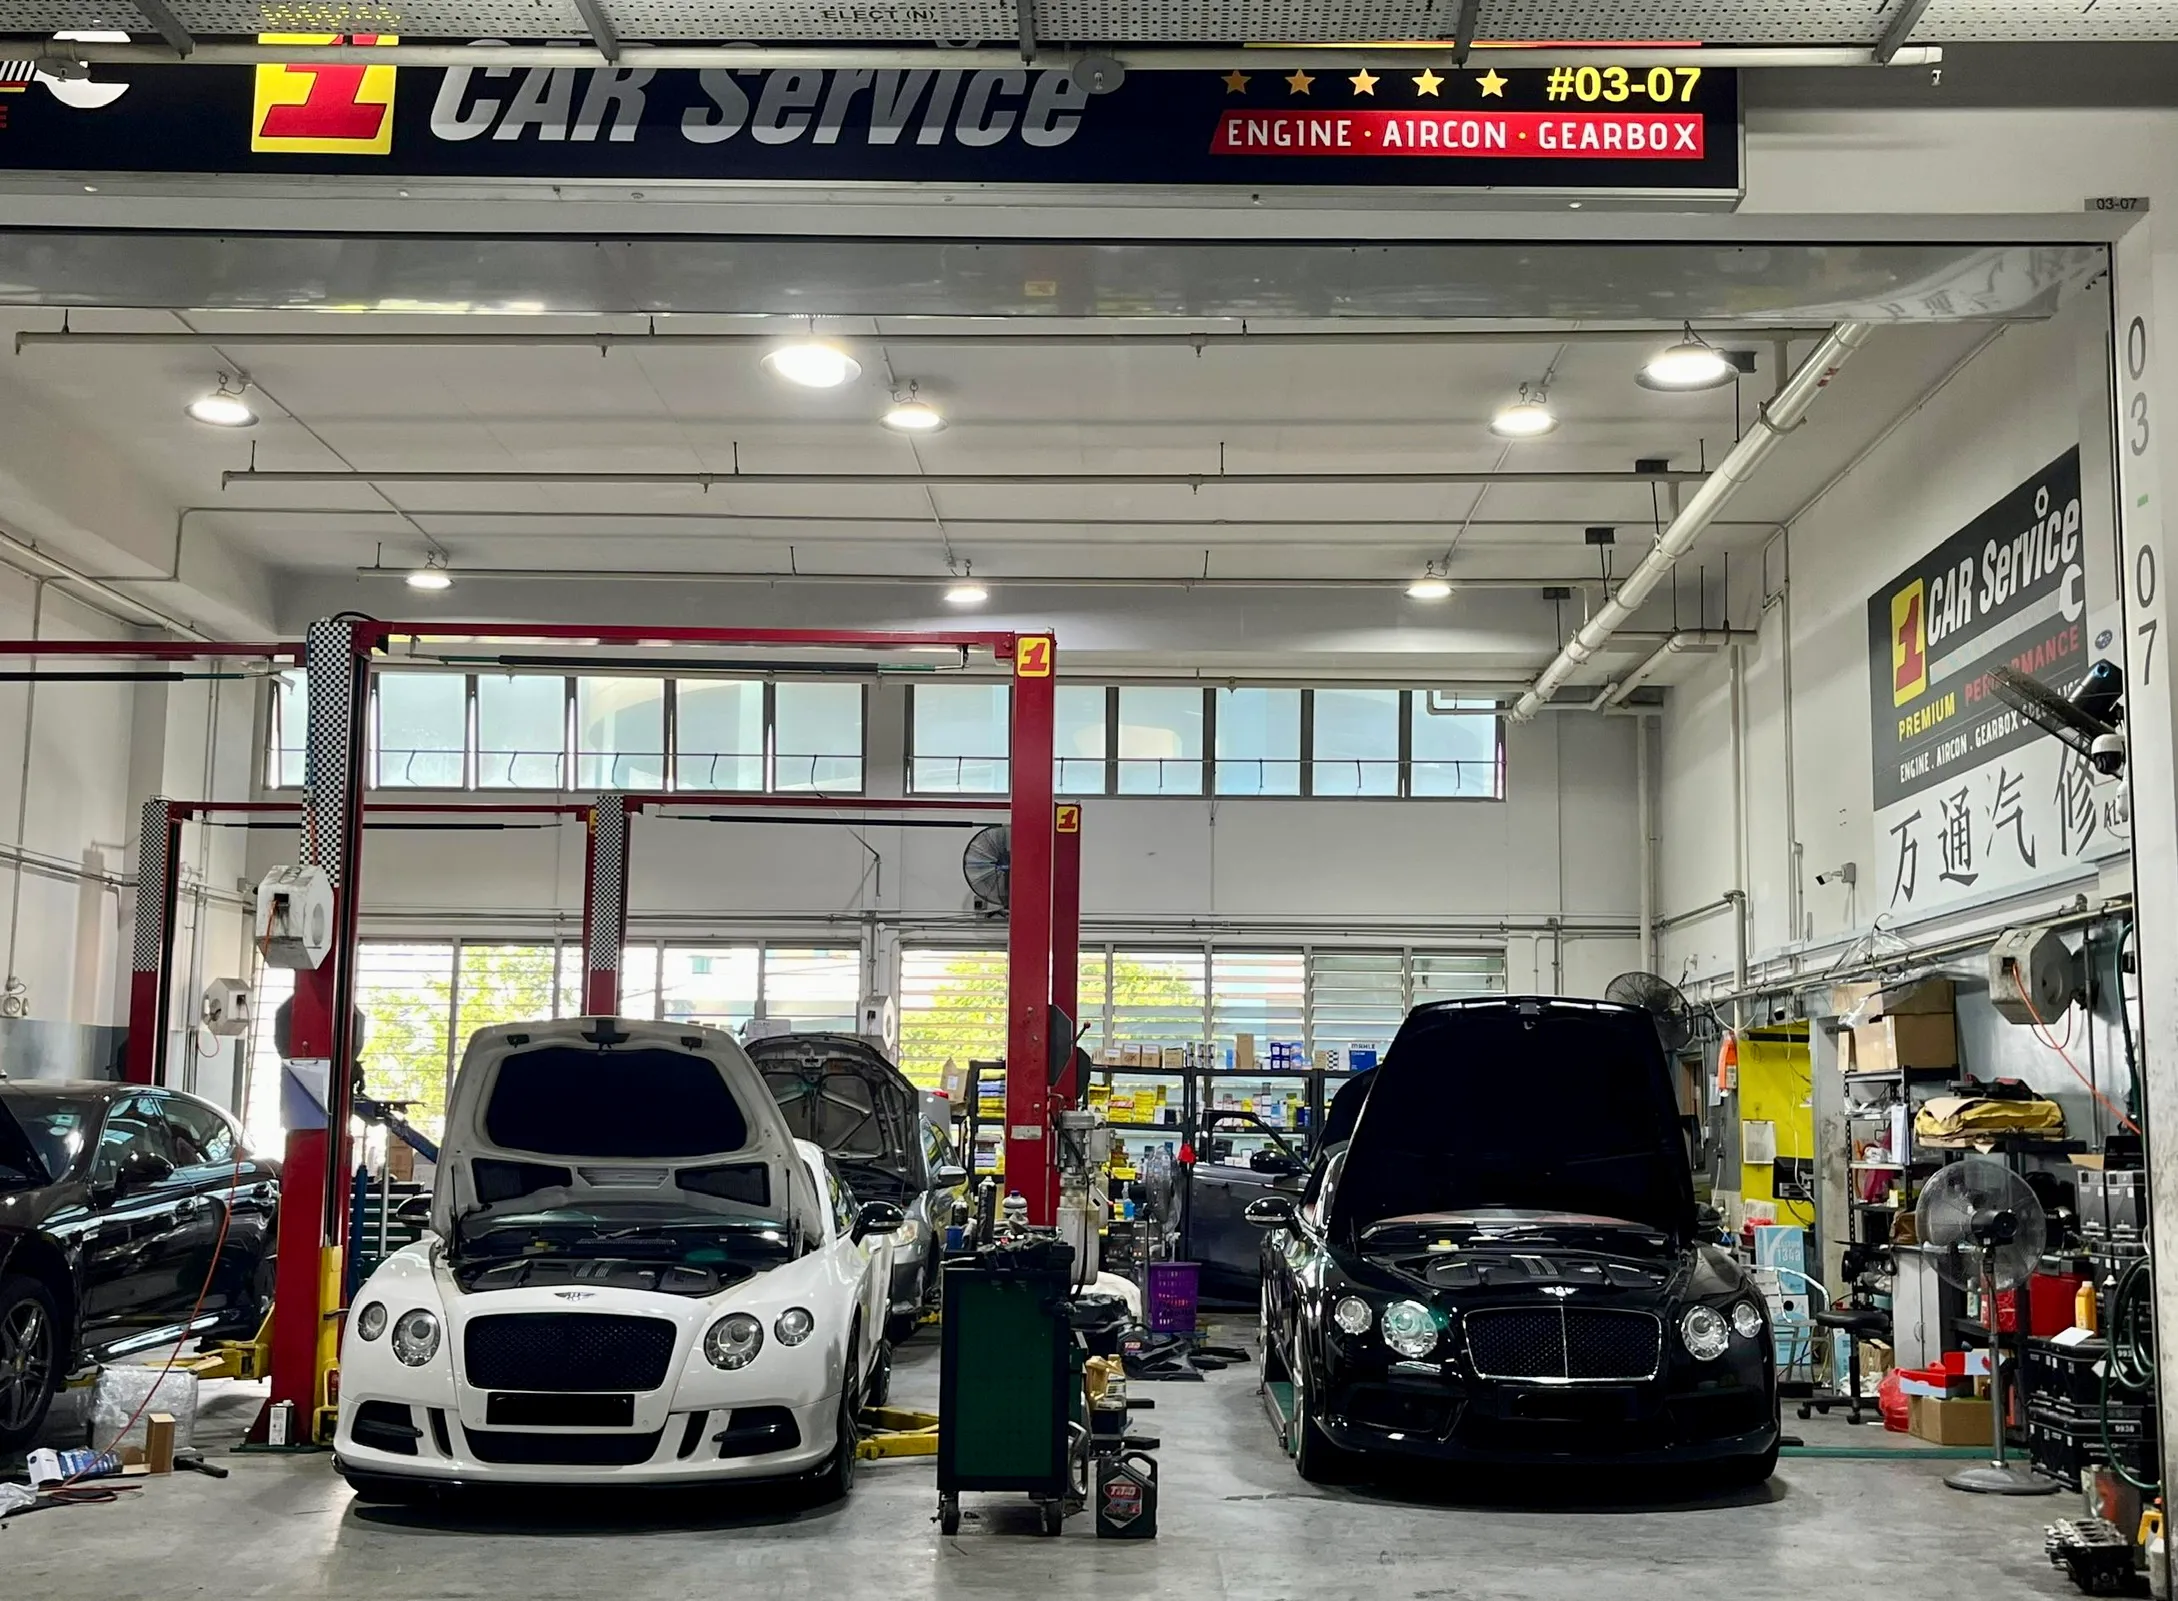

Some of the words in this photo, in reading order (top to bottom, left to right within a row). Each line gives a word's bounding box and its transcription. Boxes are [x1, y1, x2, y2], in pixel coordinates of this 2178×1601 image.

[821, 10, 899, 20] ELECT
[906, 10, 934, 20] (N)
[430, 41, 647, 142] CAR
[1546, 66, 1701, 103] #03-07
[1227, 119, 1352, 148] ENGINE
[1383, 120, 1507, 149] AIRCON
[1538, 121, 1698, 151] GEARBOX
[2096, 197, 2138, 211] 03-07
[1927, 556, 1974, 647] CAR
[1979, 490, 2081, 615] Service
[1019, 643, 1048, 672] 1
[1899, 691, 1956, 743] PREMIUM
[1963, 624, 2080, 708] PERMANCE
[1900, 751, 1931, 783] ENGINE
[1936, 732, 1969, 768] AIRCON
[1975, 709, 2019, 749] GEARBOX
[1889, 741, 2097, 909] 万通汽修
